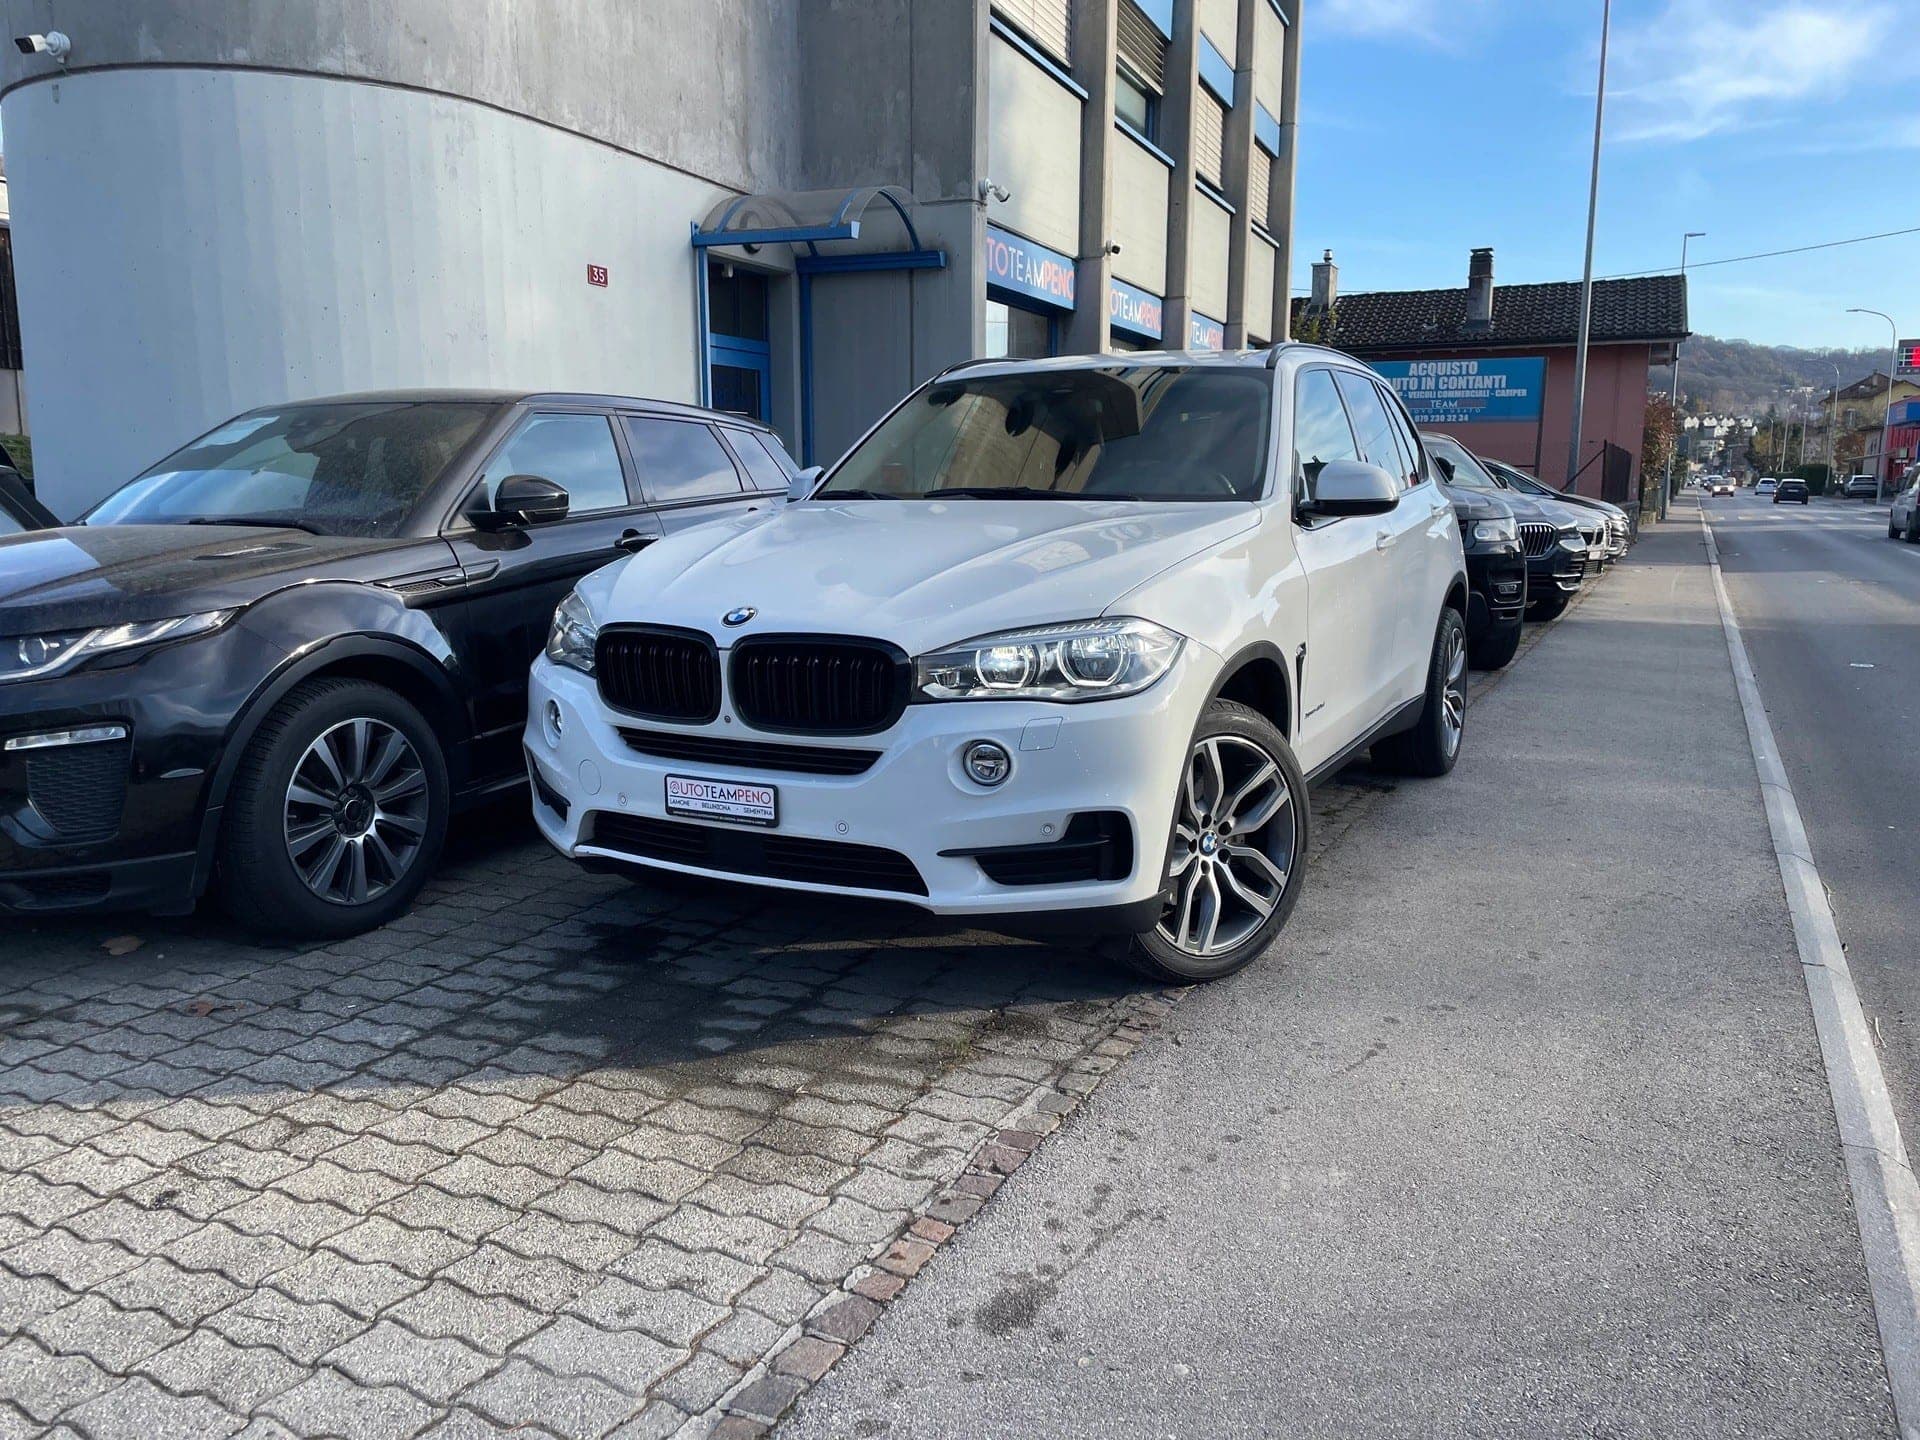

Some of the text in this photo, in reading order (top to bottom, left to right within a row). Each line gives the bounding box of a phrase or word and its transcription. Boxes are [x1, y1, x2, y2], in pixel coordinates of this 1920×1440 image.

[592, 267, 605, 282] 35
[1409, 361, 1478, 375] ACQUISTO
[1421, 377, 1435, 390] IN
[1438, 375, 1507, 389] CONTANTI
[1408, 390, 1436, 399] VEICOLI
[1437, 390, 1490, 398] COMMERCIALI
[1495, 389, 1527, 397] CAMPER
[701, 802, 731, 811] BELLINZONA
[743, 806, 773, 816] SEMENTINA
